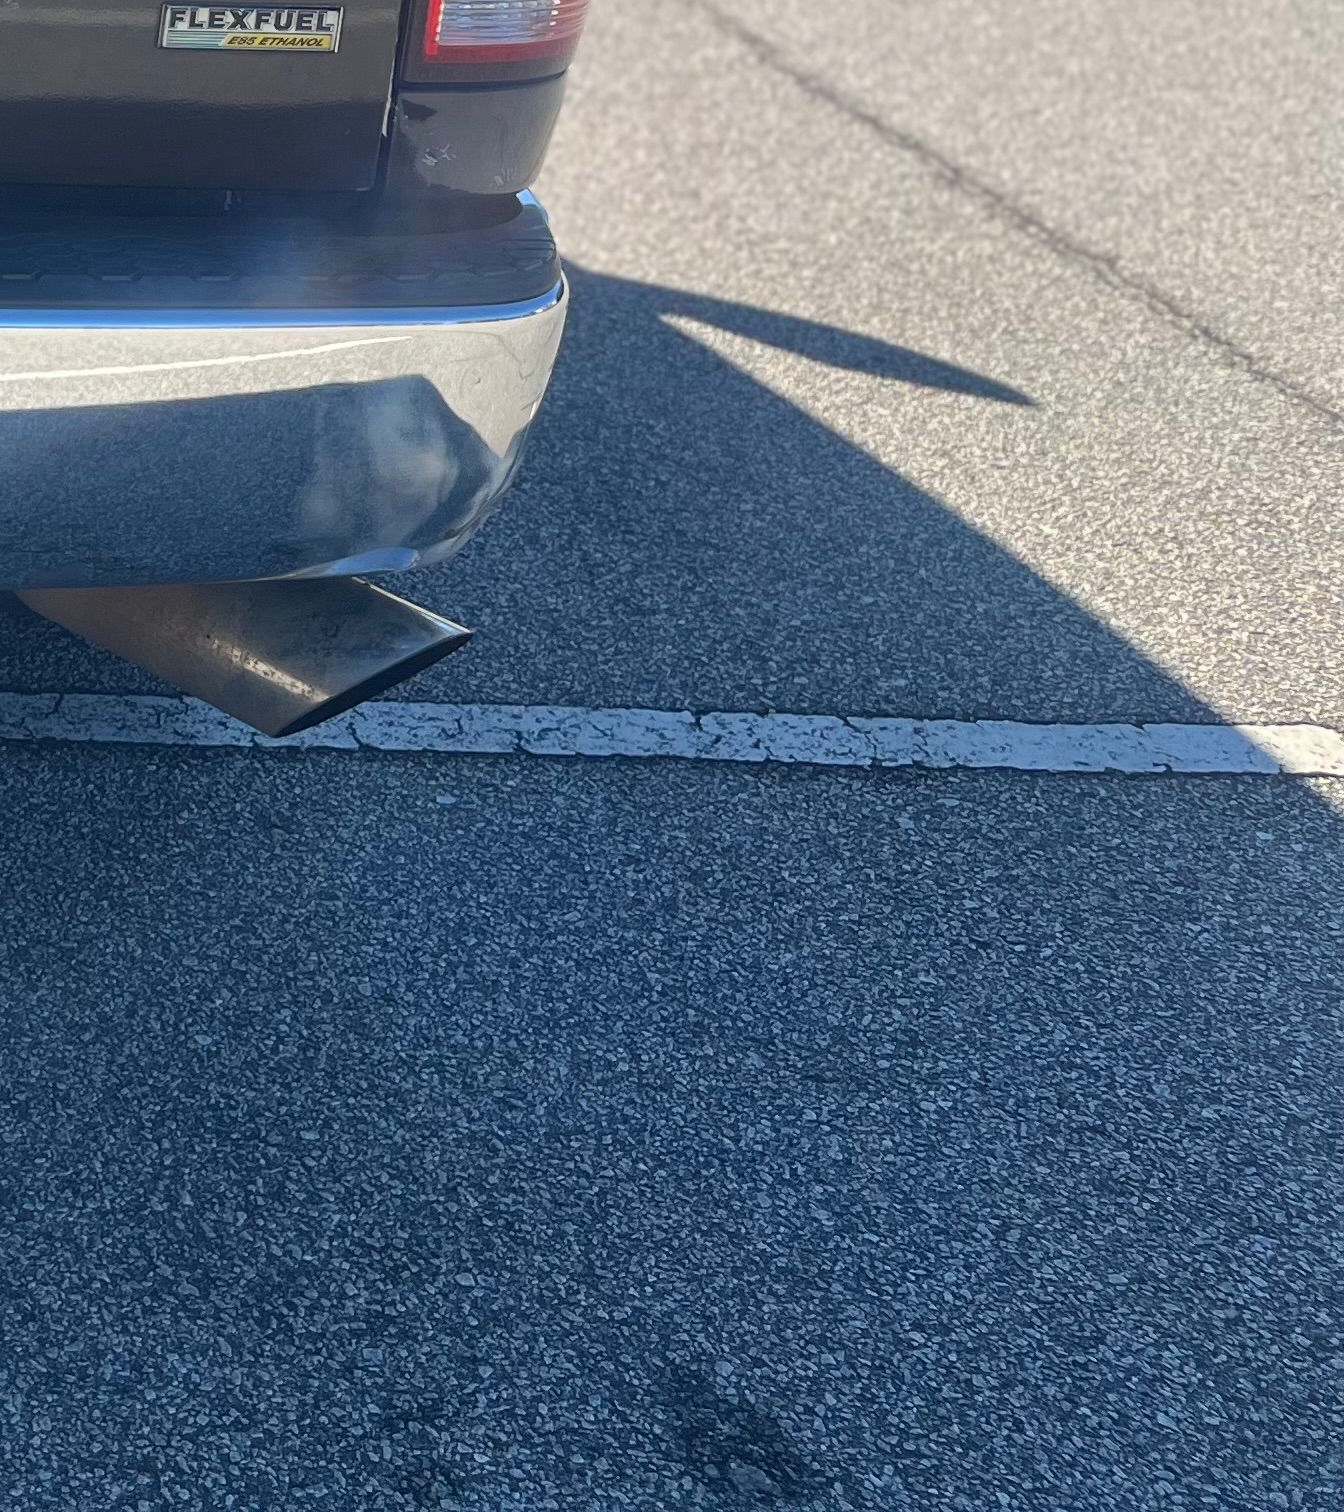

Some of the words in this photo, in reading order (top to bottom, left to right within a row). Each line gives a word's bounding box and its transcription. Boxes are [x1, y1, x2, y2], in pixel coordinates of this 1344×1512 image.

[168, 7, 335, 32] FLEXFUEL
[227, 36, 257, 46] E85
[258, 37, 324, 47] ETHANOL
